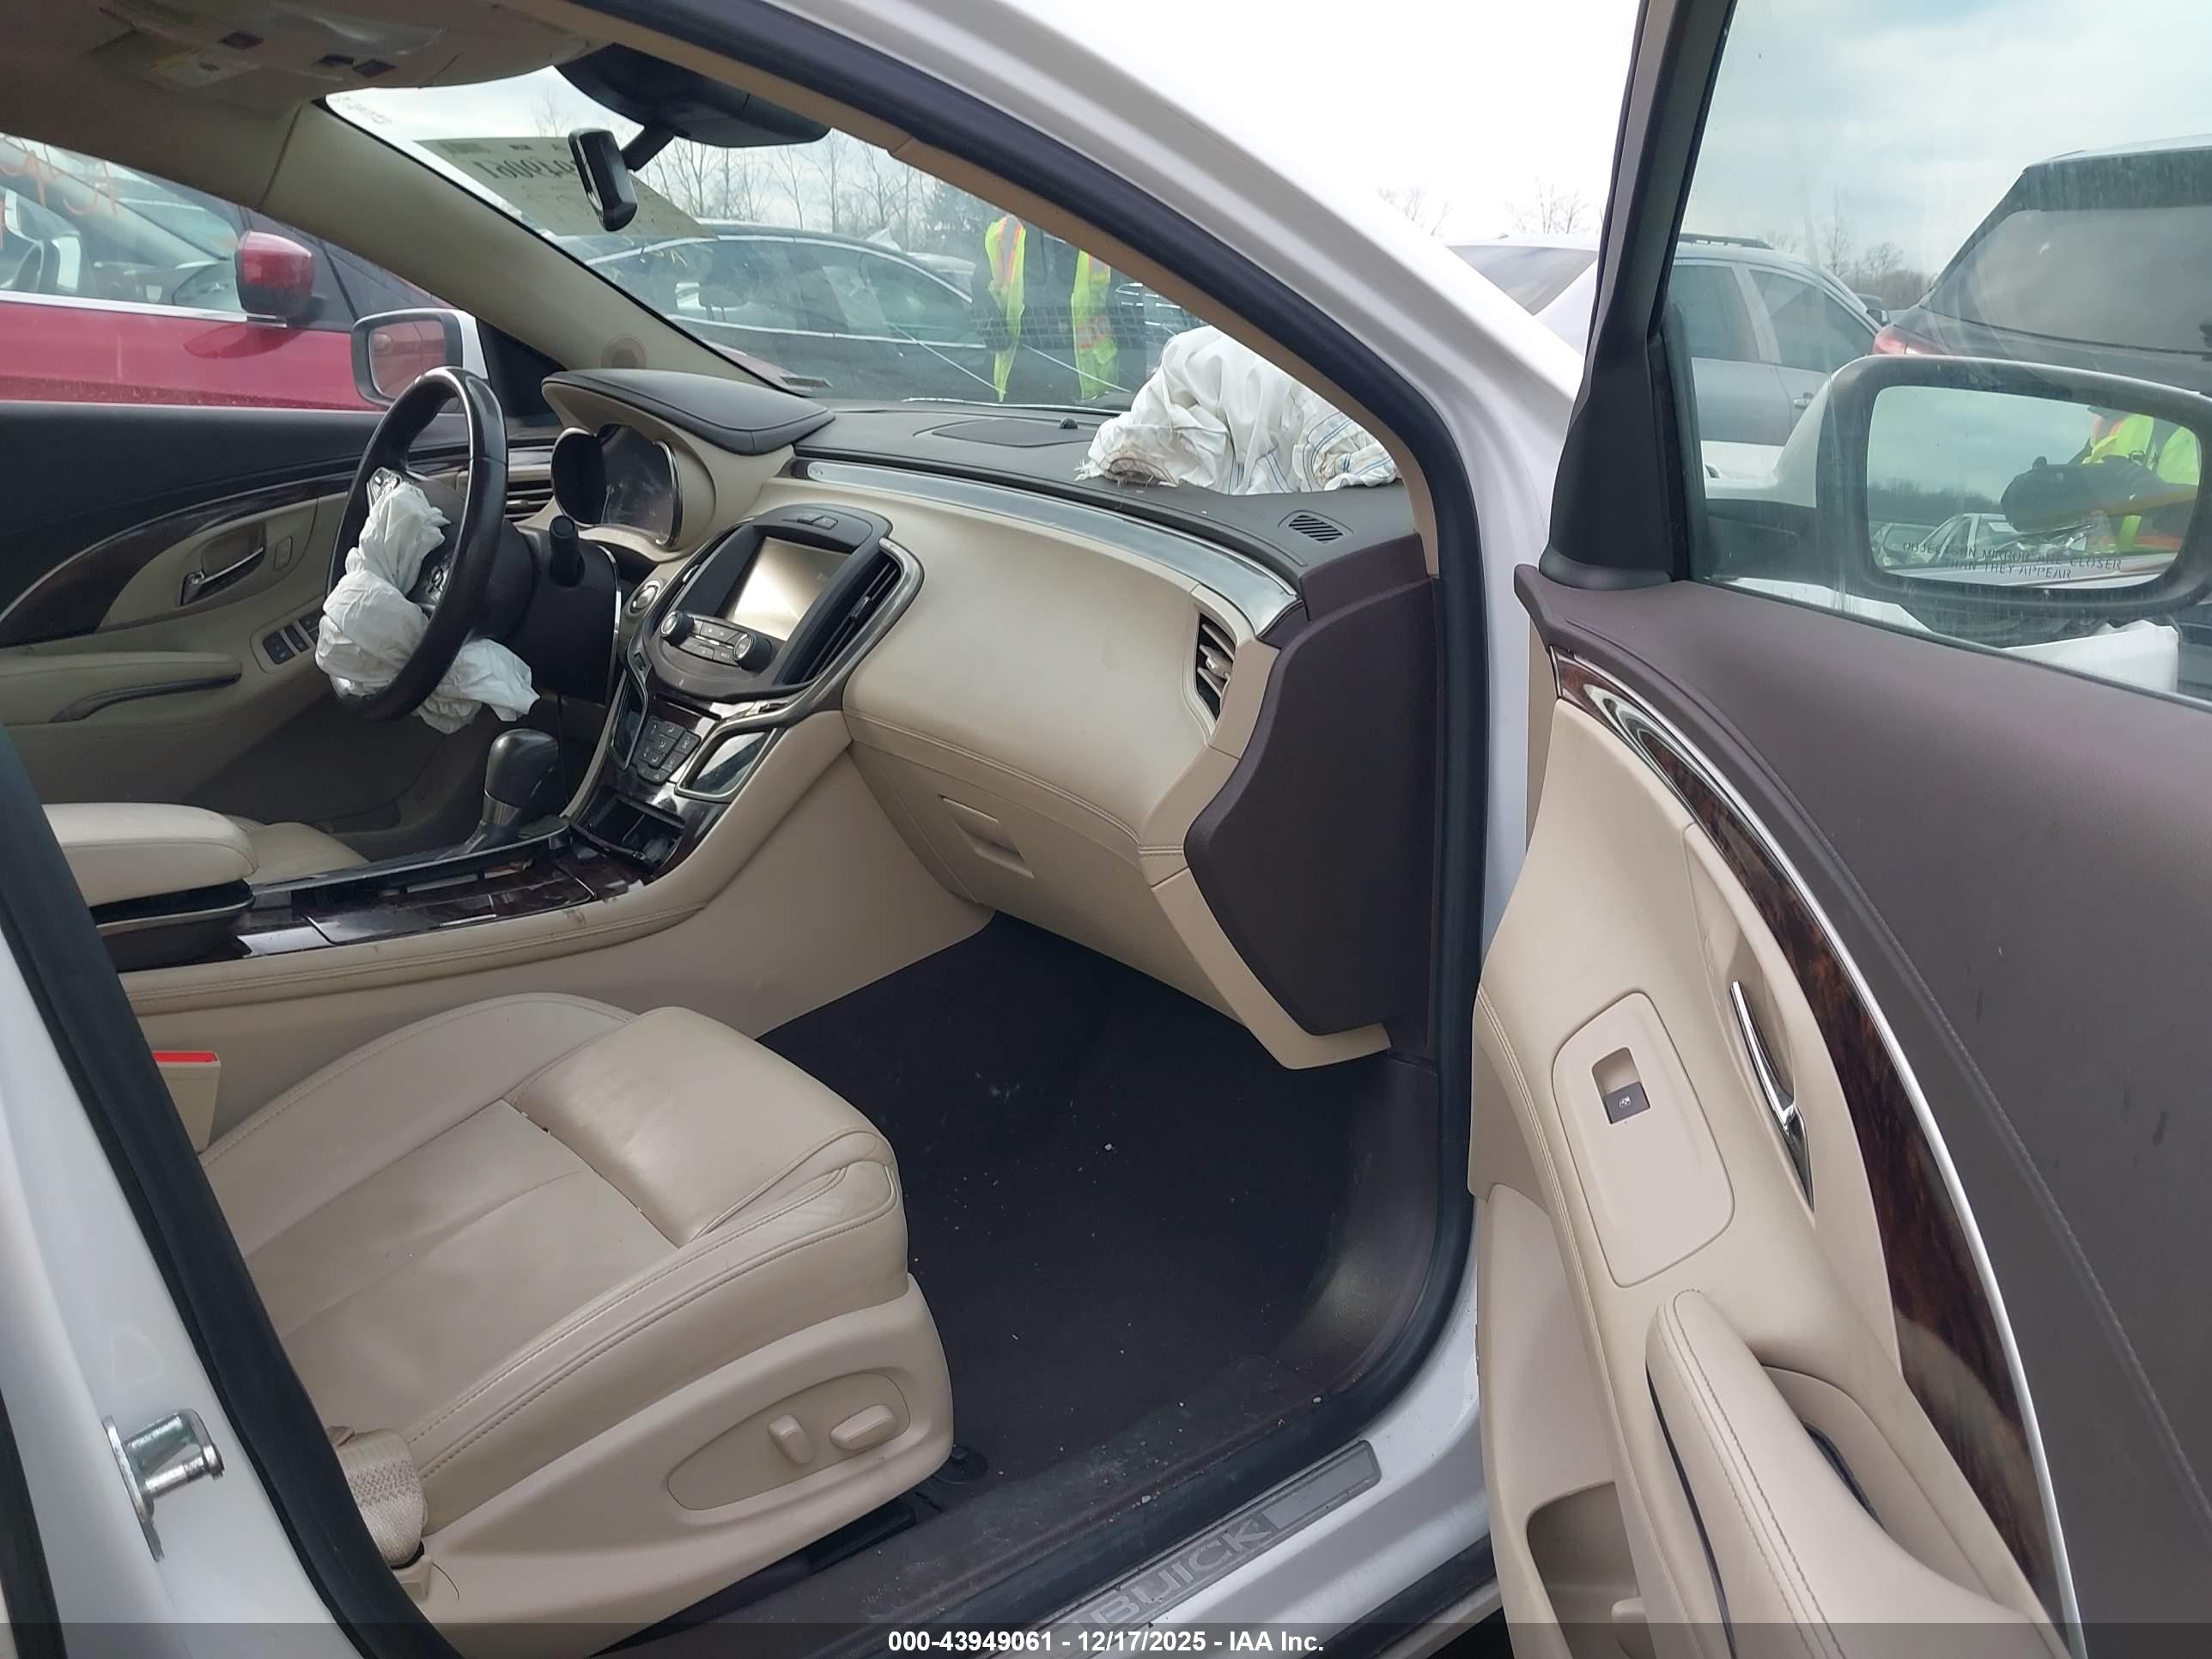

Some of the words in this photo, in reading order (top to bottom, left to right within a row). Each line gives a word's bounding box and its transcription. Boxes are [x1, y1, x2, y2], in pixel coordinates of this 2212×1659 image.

[1982, 549, 2030, 563] MIRROR
[2038, 554, 2061, 565] ARE
[2069, 556, 2122, 570] CLOSER
[1984, 562, 2014, 574] THEY
[2019, 565, 2072, 580] APPEAR
[1090, 1518, 1273, 1631] BUICK
